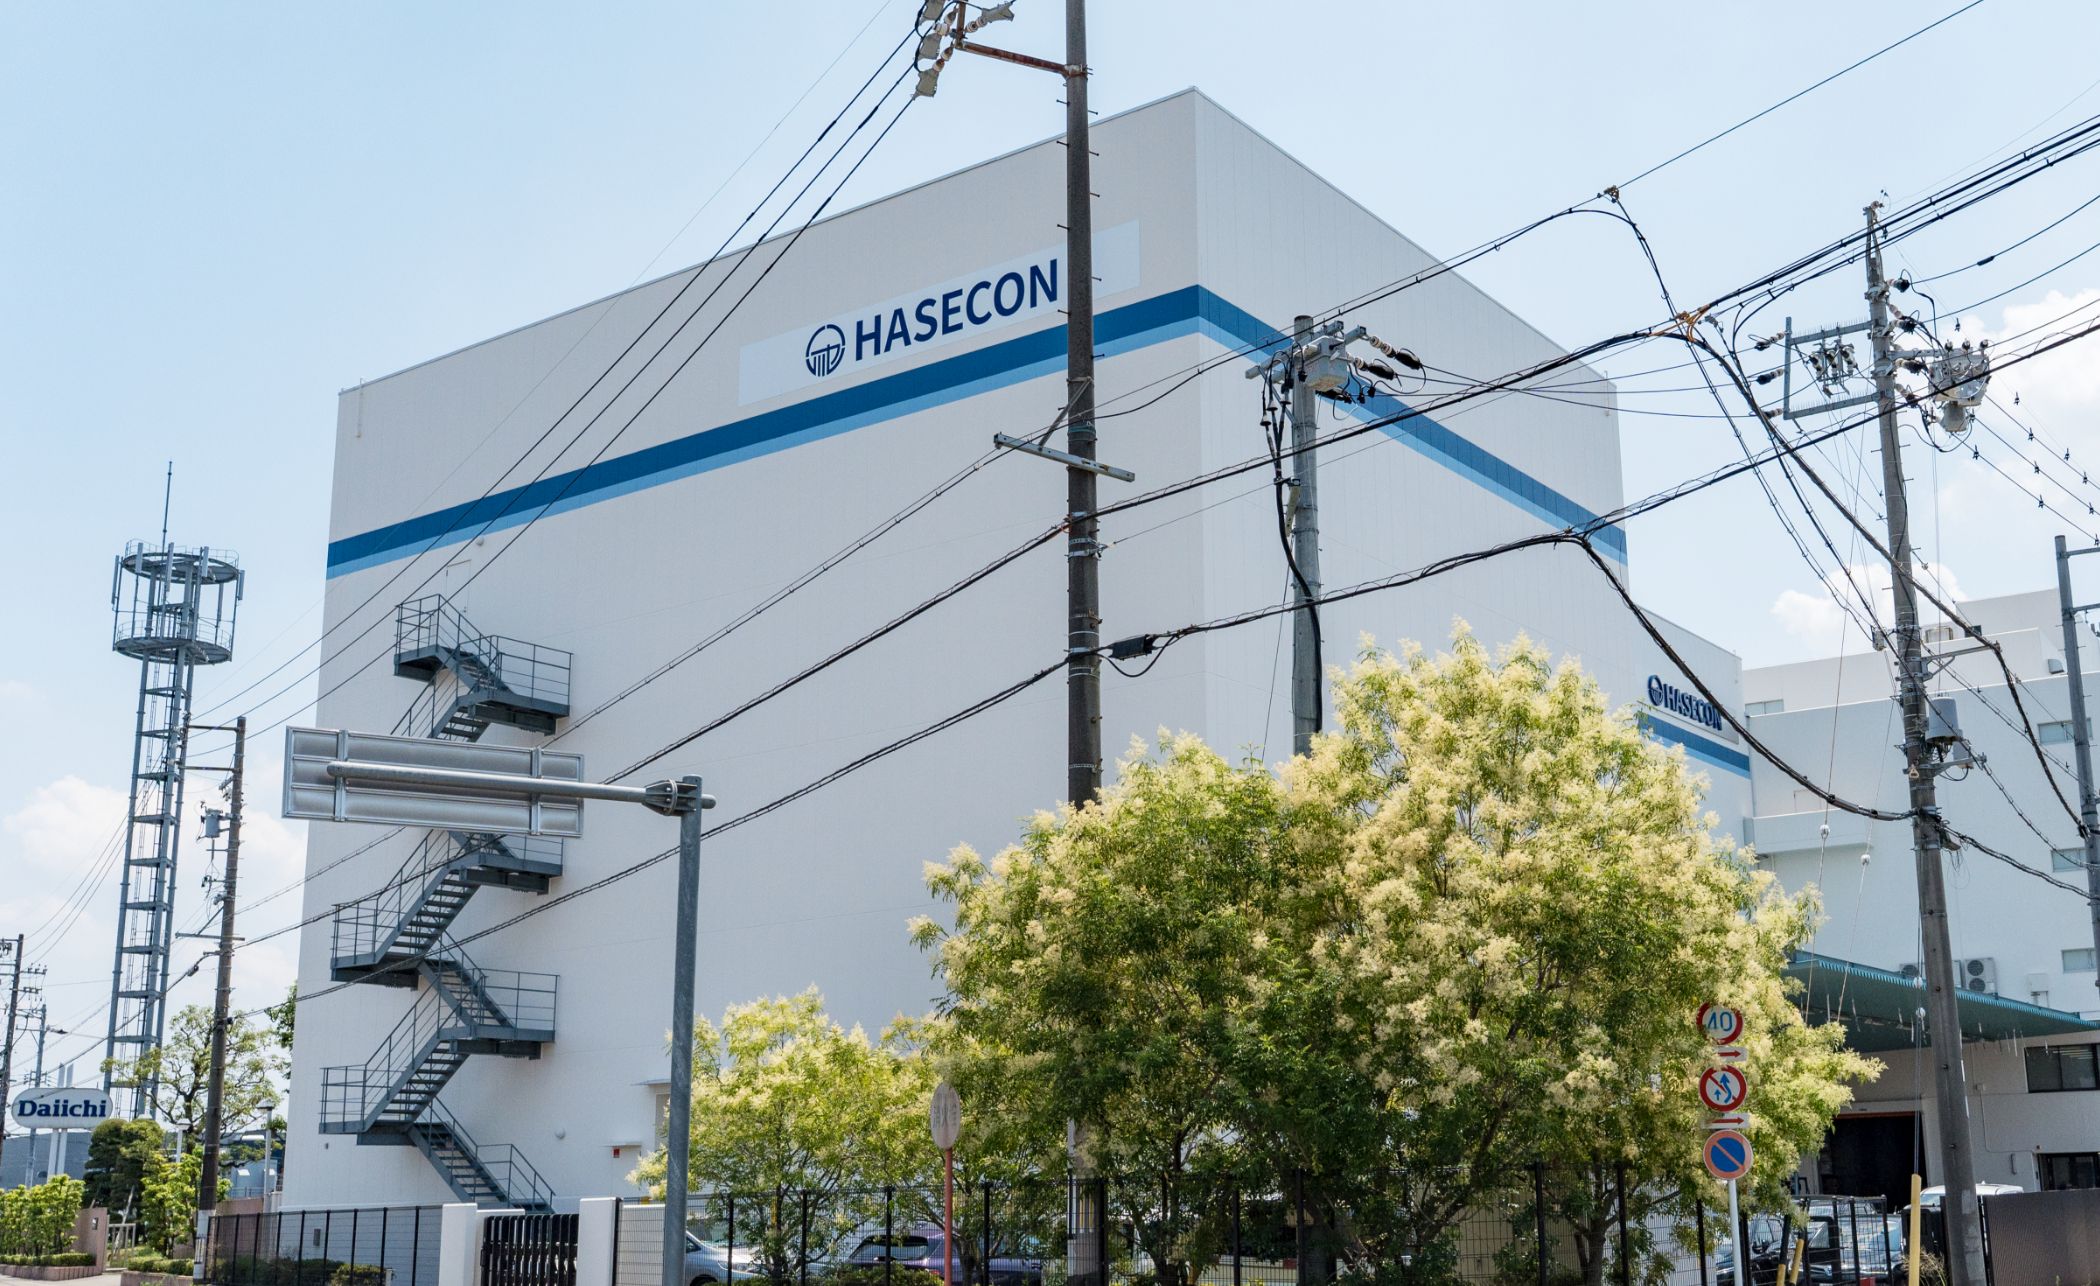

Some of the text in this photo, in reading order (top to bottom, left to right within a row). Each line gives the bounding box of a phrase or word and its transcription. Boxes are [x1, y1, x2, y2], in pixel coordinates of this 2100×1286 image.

[855, 258, 1058, 361] HASECON
[1663, 683, 1722, 731] HASECON
[1707, 1011, 1733, 1032] 40
[17, 1099, 107, 1118] Daiichi
